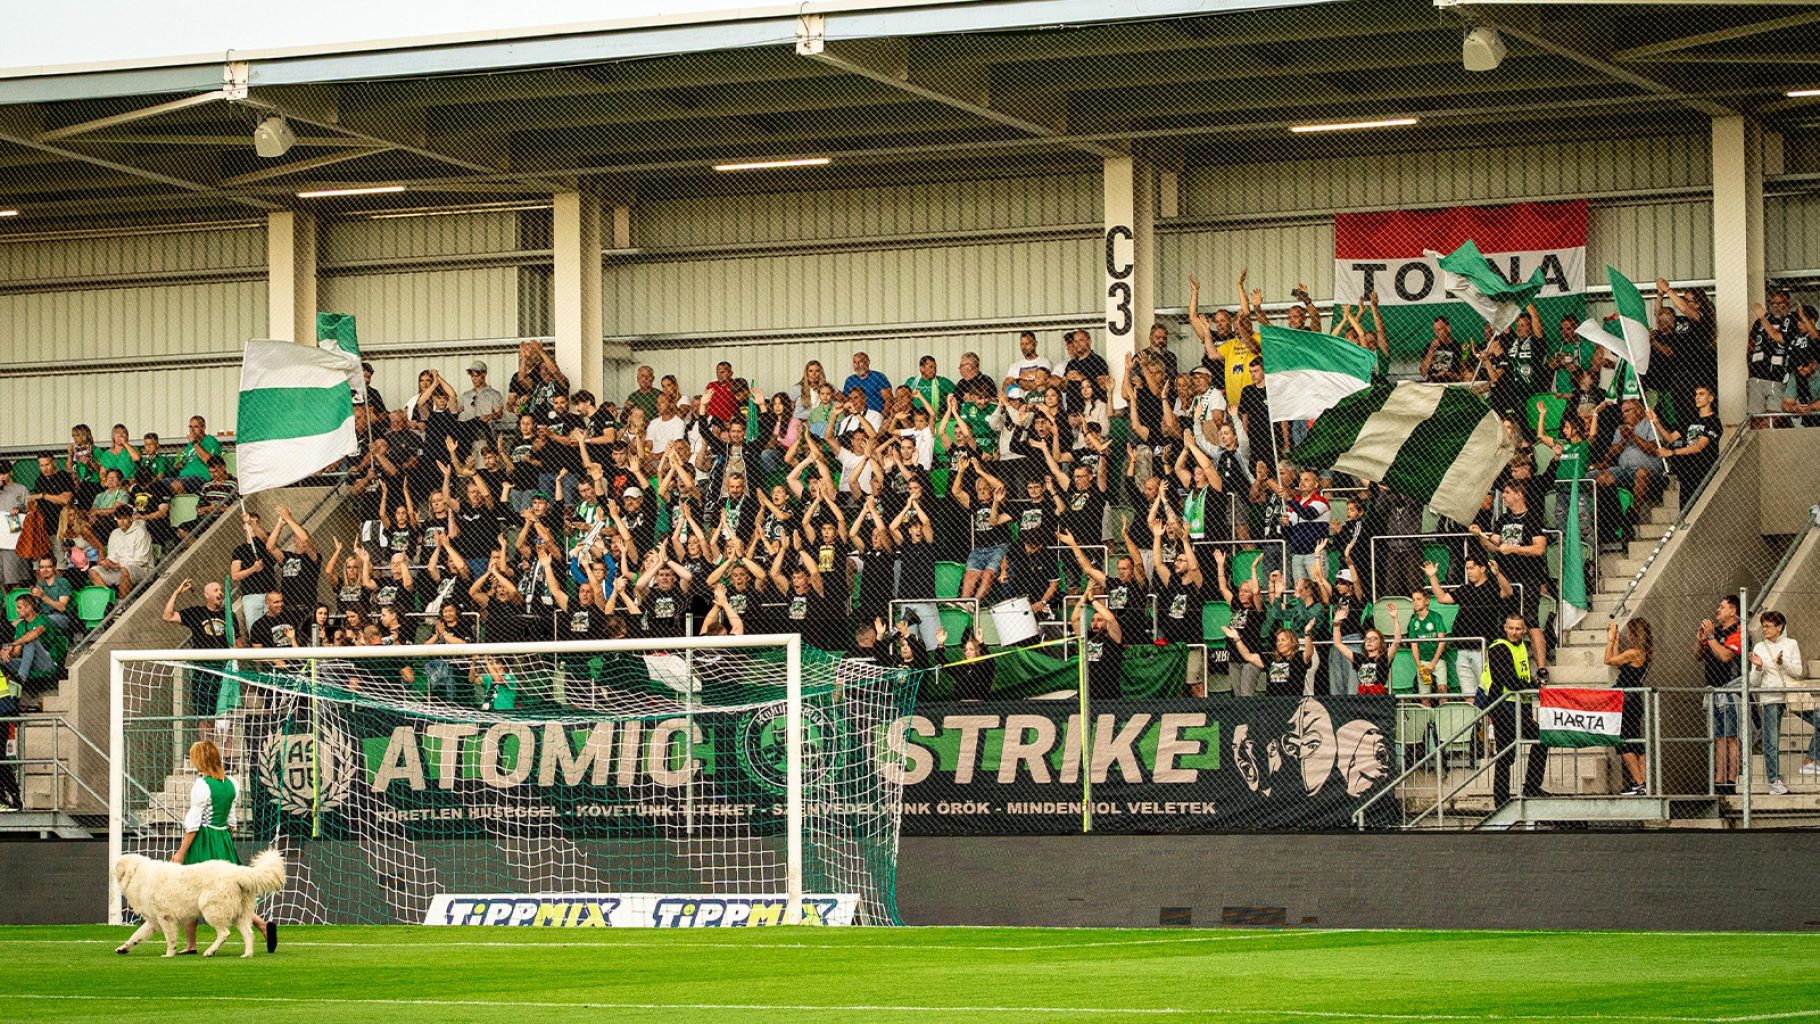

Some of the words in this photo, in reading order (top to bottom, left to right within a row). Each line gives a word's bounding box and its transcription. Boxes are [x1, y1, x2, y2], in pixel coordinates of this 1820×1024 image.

[1352, 254, 1570, 302] TONA
[1553, 711, 1605, 730] HARTA
[371, 718, 703, 793] ATOMIC
[881, 713, 1207, 785] STRIKE
[679, 804, 756, 816] TTEKET
[936, 800, 990, 815] ÖRÖK
[1122, 802, 1216, 815] VELETEK
